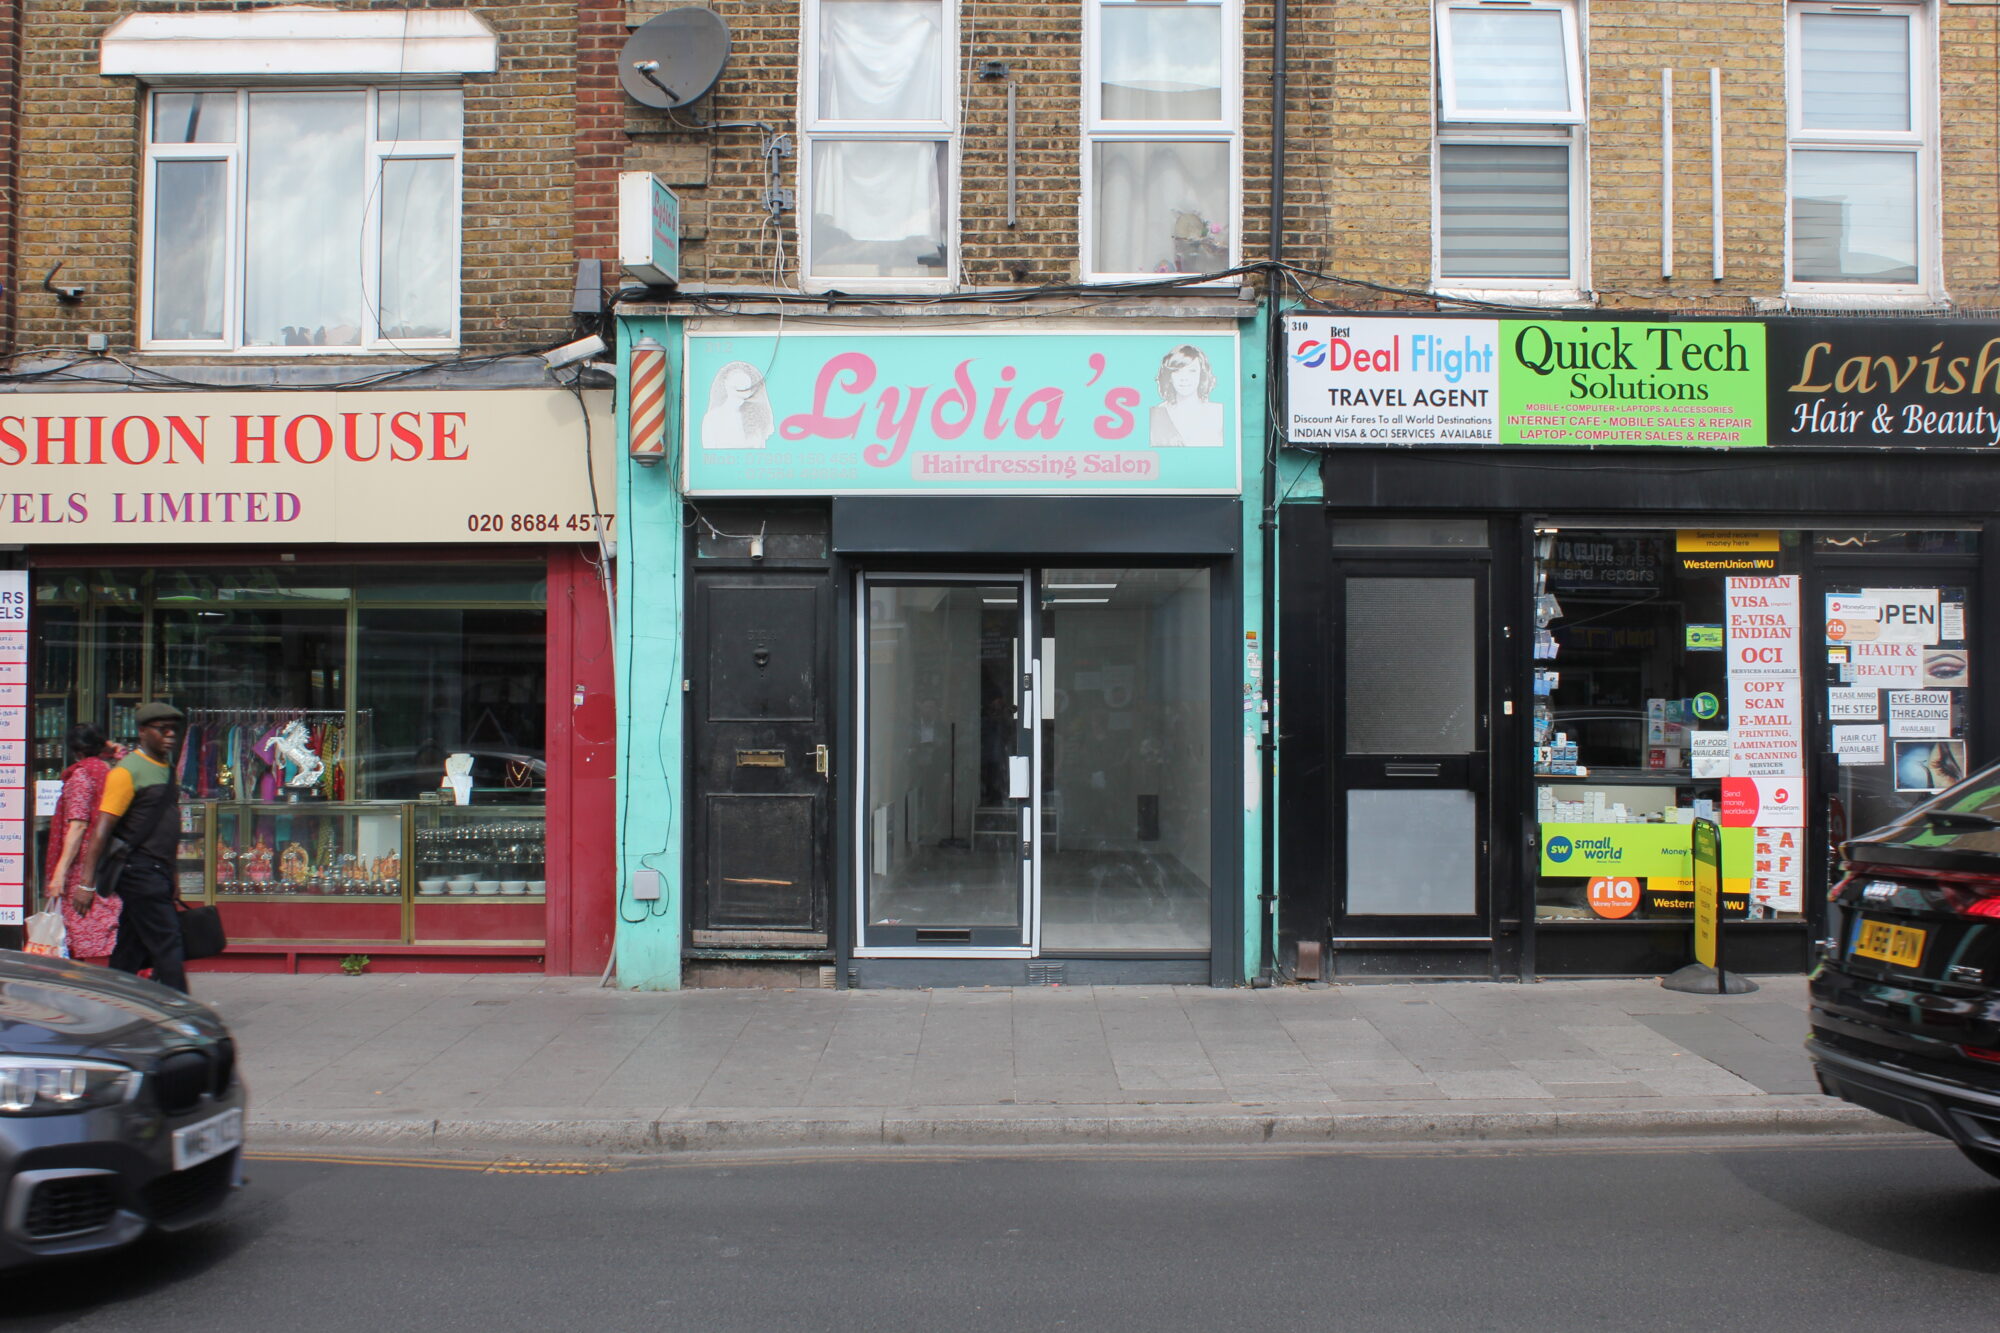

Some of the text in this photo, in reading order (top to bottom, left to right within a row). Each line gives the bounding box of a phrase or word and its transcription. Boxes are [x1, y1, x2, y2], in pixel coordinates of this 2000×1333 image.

[1291, 321, 1308, 332] 310
[1330, 326, 1351, 338] Best
[1514, 325, 1750, 376] Quick Tech
[1330, 334, 1493, 384] Deal Flight
[1787, 337, 2000, 394] Lavish
[1569, 372, 1709, 401] Solutions
[1328, 388, 1489, 407] TRAVEL AGENT
[779, 351, 1141, 468] Lydia's
[1525, 404, 1734, 414] MOBILE COMPUTER LAPTOPS & ACCESSORIES
[1293, 414, 1493, 425] Discount Air Fares To all World Destinations
[1507, 416, 1752, 429] INTERNET CAFE MOBILE SALES & REPAIR
[1790, 398, 2000, 446] Hair & Beauty
[229, 411, 470, 464] HOUSE
[1294, 428, 1493, 439] INDIAN VISA & OCI SERVICES AVAILABLE
[1519, 429, 1740, 442] LAPTOP COMPUTER SALES & REPAIR
[921, 453, 1152, 480] Hairdressing Salon
[0, 491, 302, 524] ELS LIMITED
[466, 513, 616, 532] 020 8684 4577
[1706, 540, 1732, 548] money
[1683, 558, 1775, 569] WesternUnion WU
[1600, 567, 1656, 583] repairs
[1730, 577, 1792, 589] INDIAN
[1730, 595, 1769, 607] VISA
[1731, 614, 1787, 626] E-VISA
[1877, 603, 1935, 625] PEN
[1827, 621, 1844, 632] ria
[1731, 627, 1793, 639] INDIAN
[1741, 647, 1784, 664] OCI
[1858, 643, 1918, 657] HAIR &
[1857, 664, 1918, 677] BEAUTY
[1744, 681, 1785, 692] COPY
[1831, 691, 1877, 699] PLEASE MIND
[1891, 693, 1949, 704] EYE-BROW
[1745, 698, 1785, 709] SCAN
[1831, 704, 1877, 714] THE STEP
[1891, 709, 1949, 718] THREADING
[1738, 714, 1792, 726] E-MAIL
[1693, 738, 1706, 746] AIR
[1840, 734, 1877, 742] HAIR CUT
[1733, 740, 1798, 749] LAMINATION
[1838, 745, 1880, 753] AVAILABLE
[1734, 752, 1798, 761] & SCANNING
[1723, 790, 1741, 798] Send
[1723, 800, 1745, 808] money
[1762, 804, 1800, 812] MoneyGram
[1575, 836, 1611, 849] small
[1584, 847, 1623, 859] world
[1661, 847, 1687, 856] Money
[1593, 876, 1633, 899] ria
[1727, 901, 1745, 910] WU
